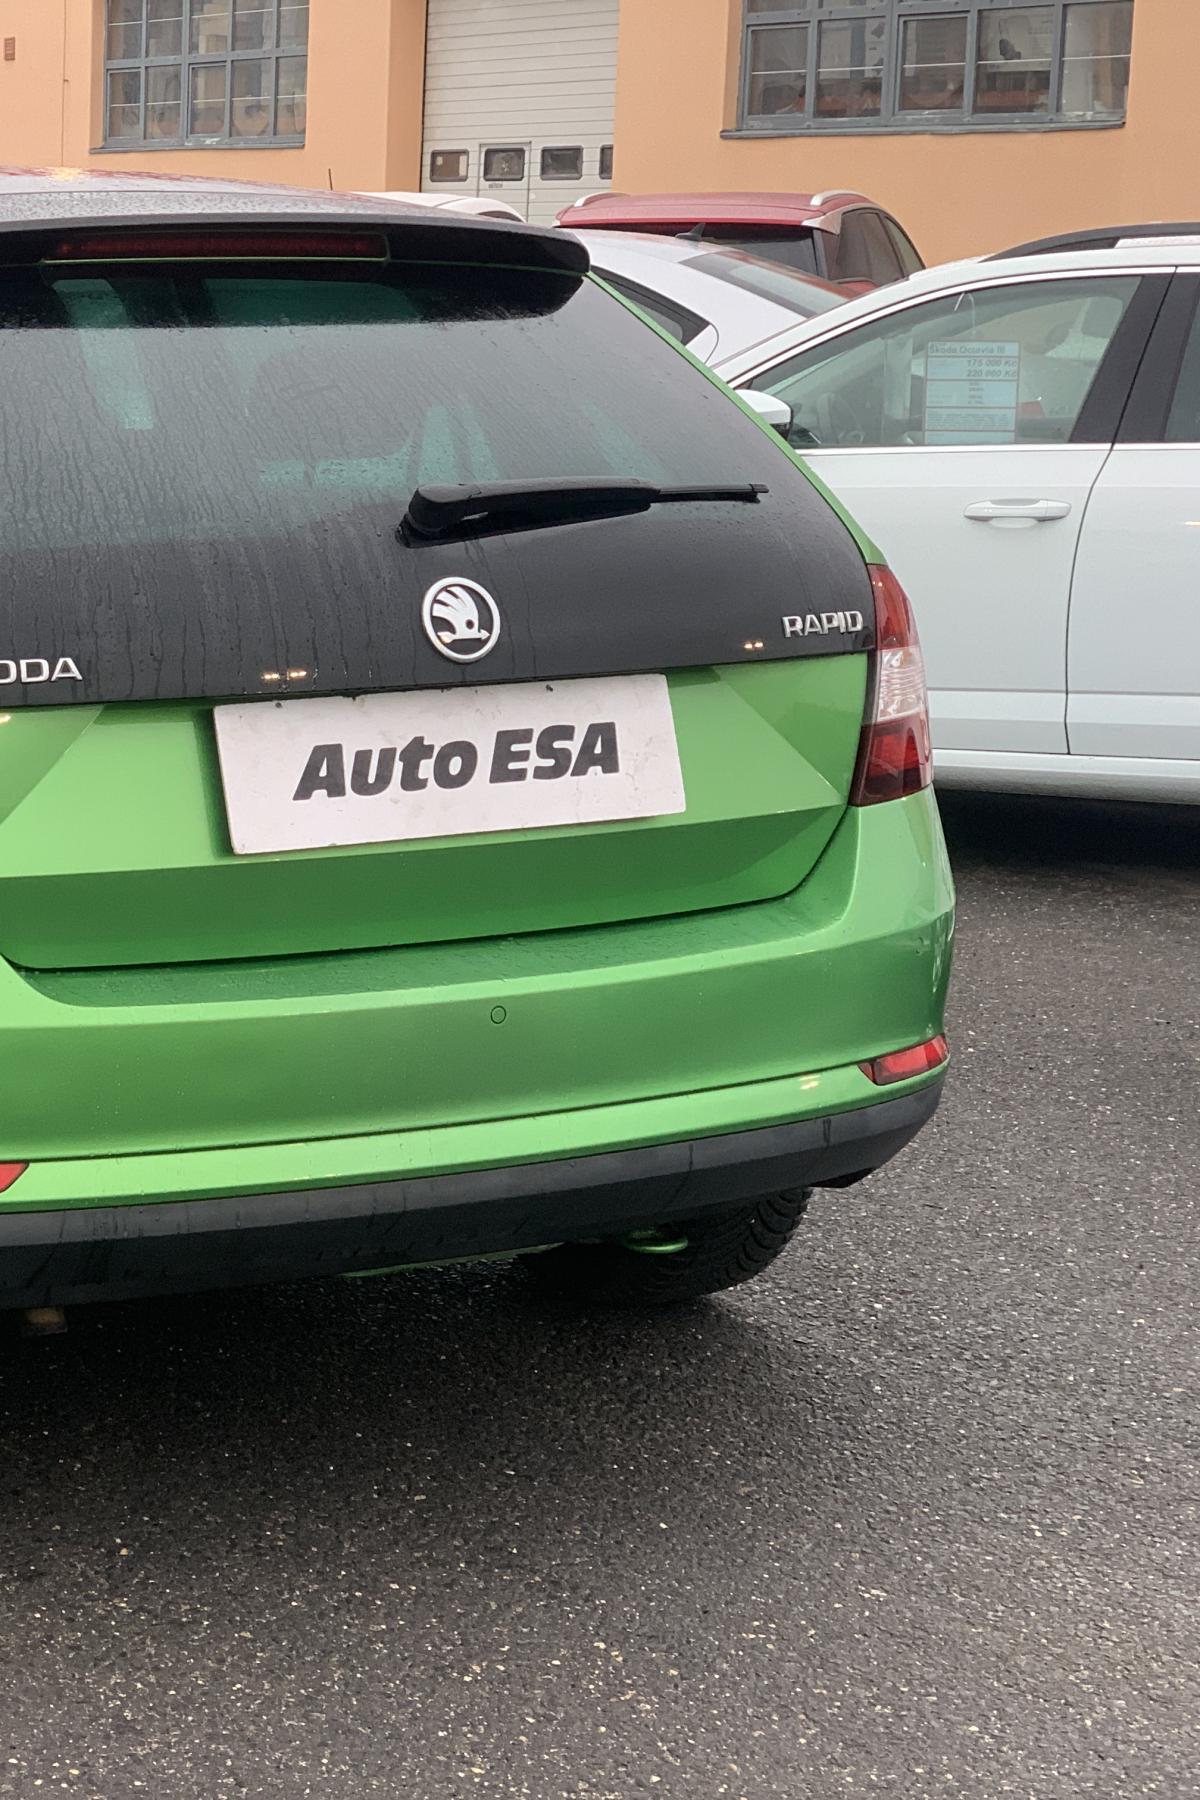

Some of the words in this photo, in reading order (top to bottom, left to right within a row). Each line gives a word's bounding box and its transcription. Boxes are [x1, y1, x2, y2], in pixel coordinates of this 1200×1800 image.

[782, 610, 864, 638] RAPID
[293, 736, 478, 801] Auto
[489, 721, 620, 784] ESA
